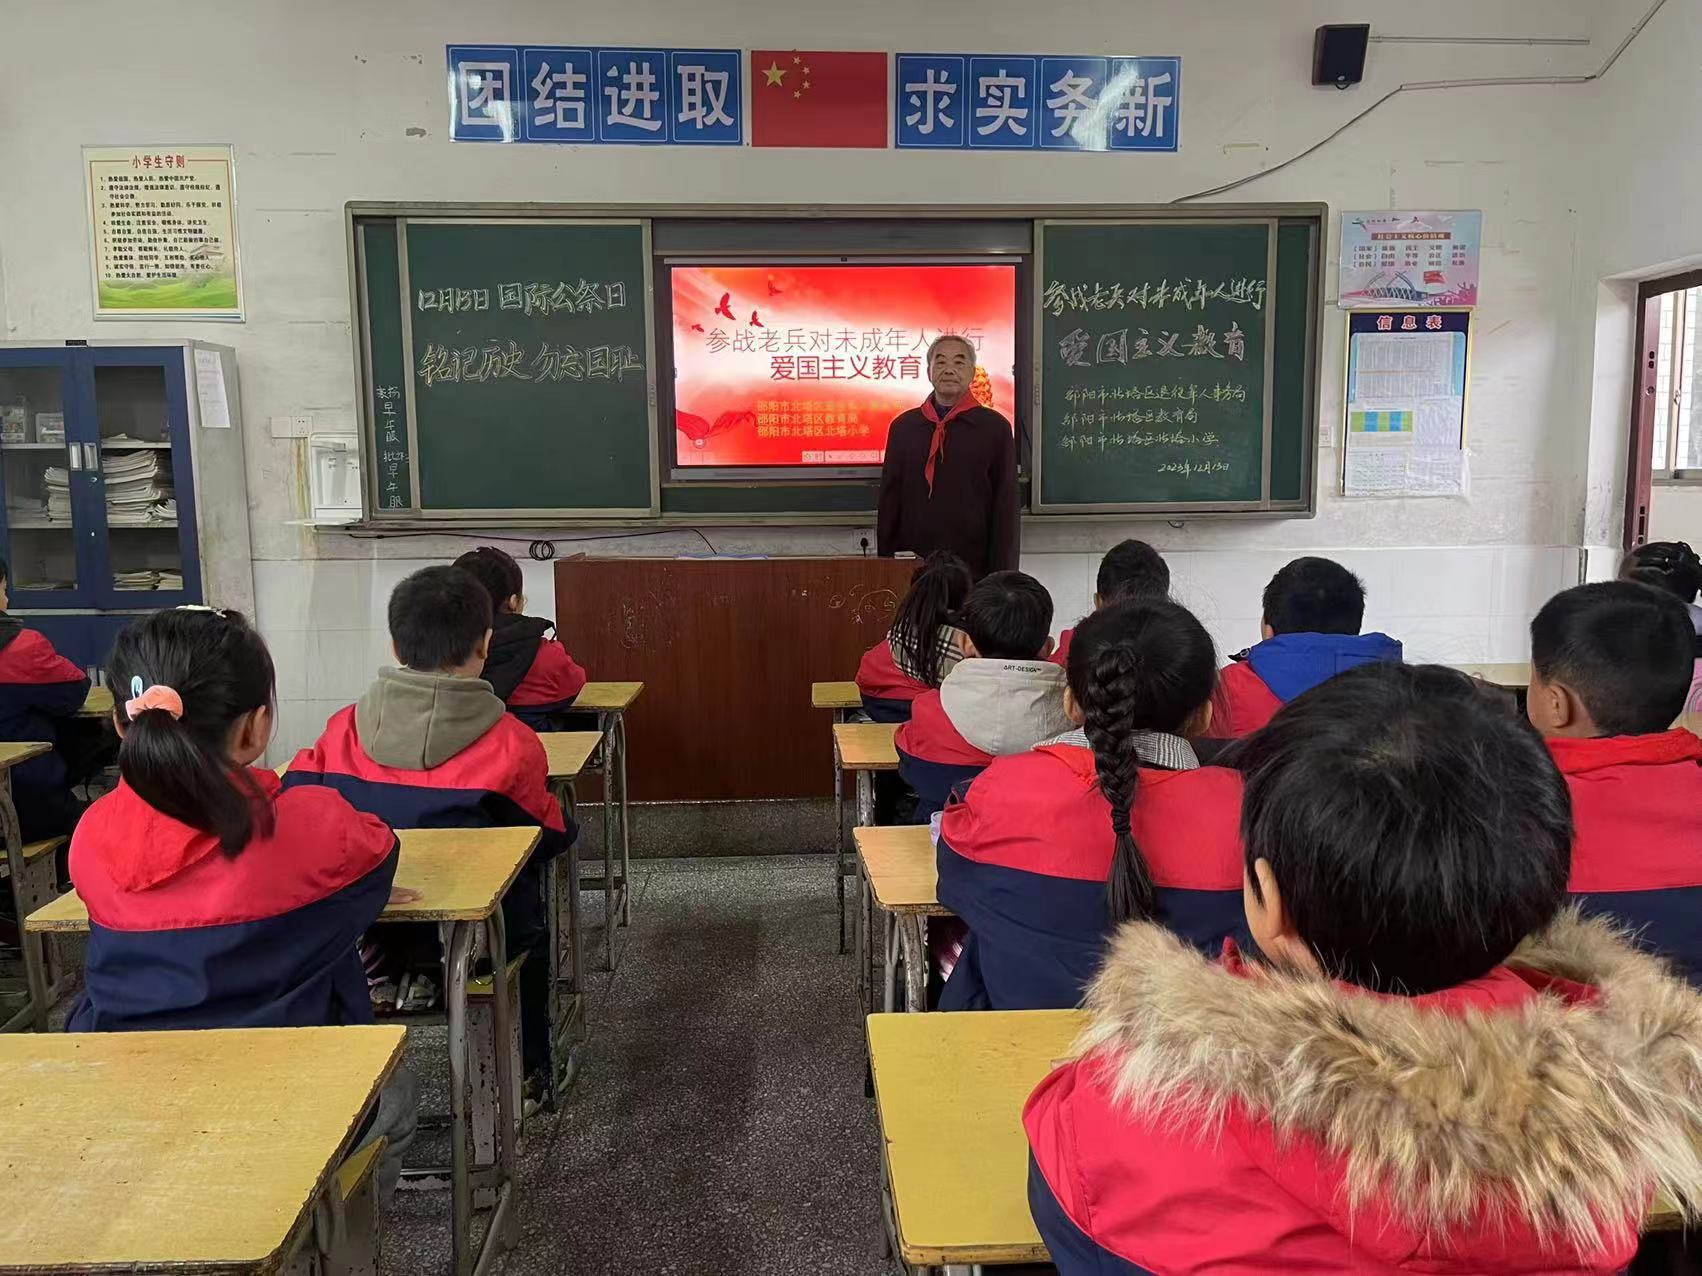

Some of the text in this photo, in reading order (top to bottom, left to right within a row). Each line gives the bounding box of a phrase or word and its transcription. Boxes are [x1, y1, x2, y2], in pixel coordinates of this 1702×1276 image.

[458, 62, 734, 130] 团结进取
[903, 68, 1174, 138] 求实务新
[132, 154, 186, 169] 小学生守则
[1058, 320, 1246, 367] 爱国主义教育
[1376, 315, 1443, 331] 信息表
[417, 340, 645, 387] 铭记历史 勿忘国耻
[770, 353, 923, 381] 爱国主义教育
